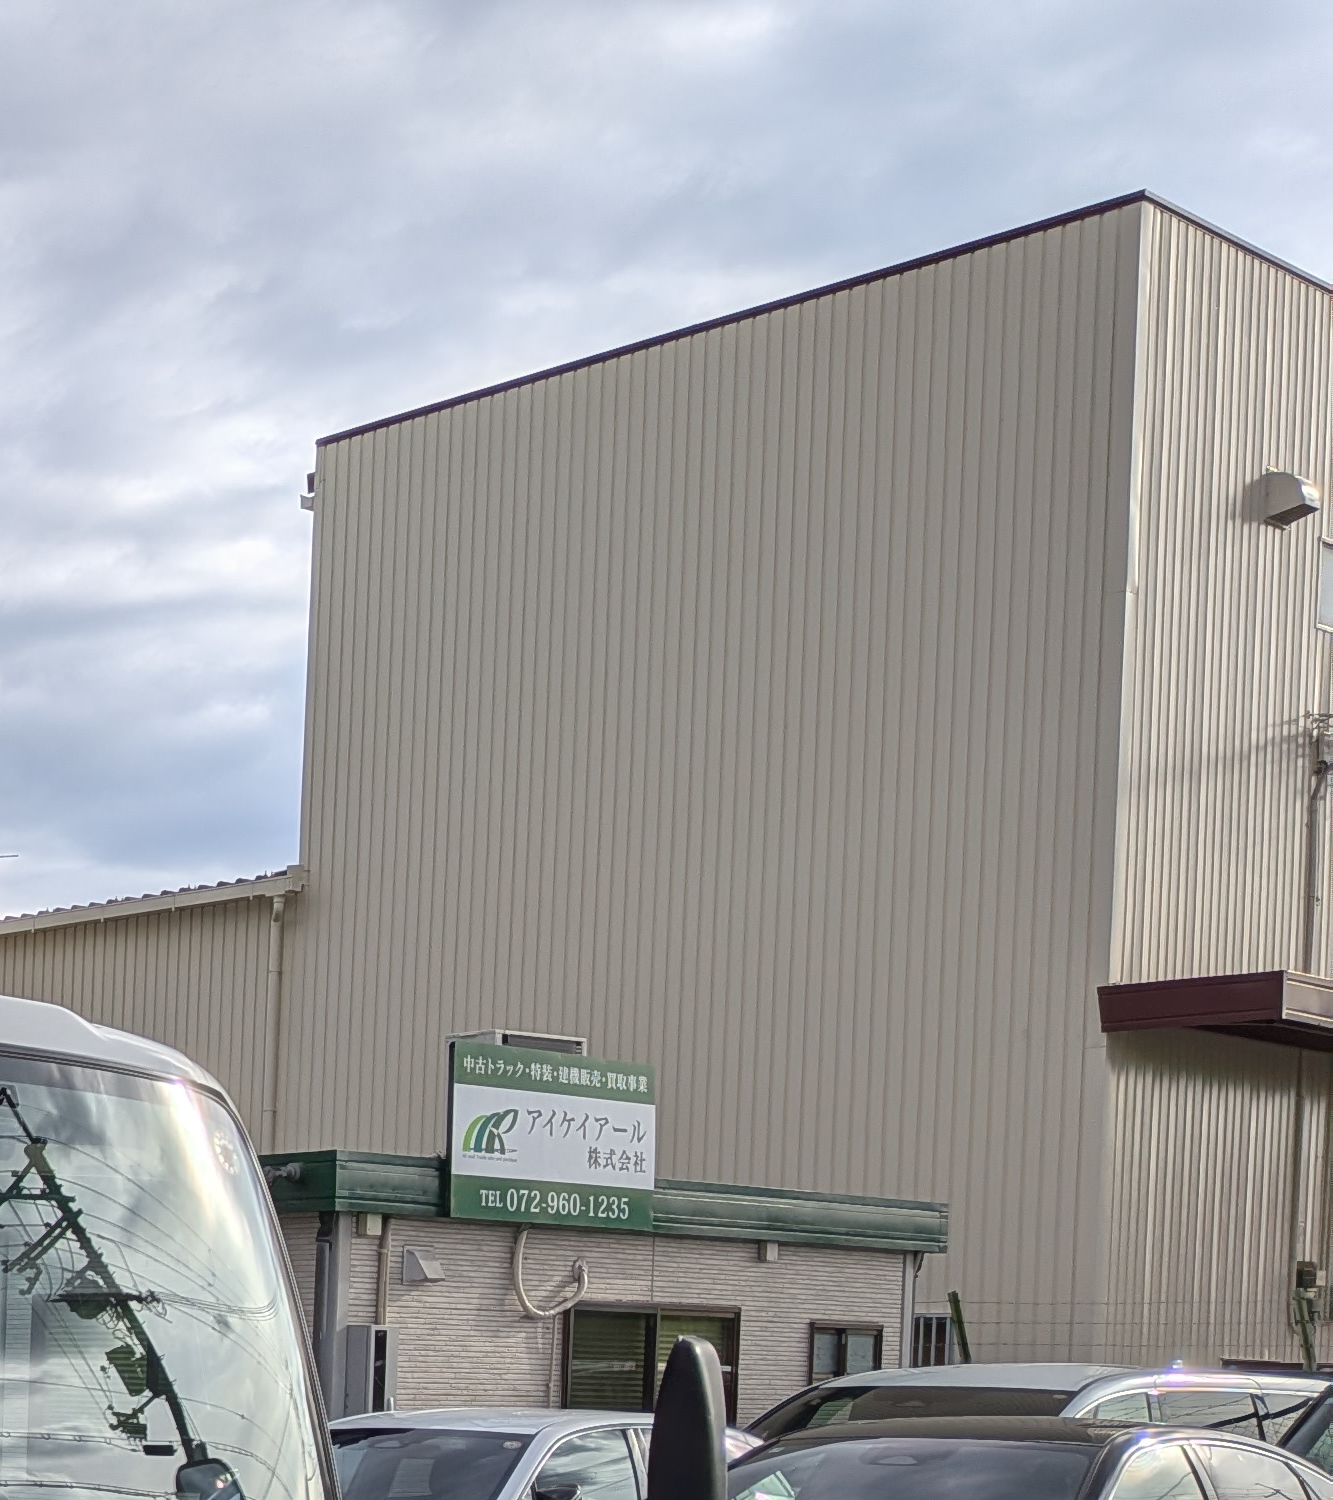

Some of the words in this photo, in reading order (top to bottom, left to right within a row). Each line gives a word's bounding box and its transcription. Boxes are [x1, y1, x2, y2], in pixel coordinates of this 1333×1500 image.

[526, 1108, 647, 1144] アイケイアール
[587, 1146, 647, 1174] 株式会社
[480, 1189, 504, 1208] TEL
[506, 1188, 630, 1220] 072-960-1235
